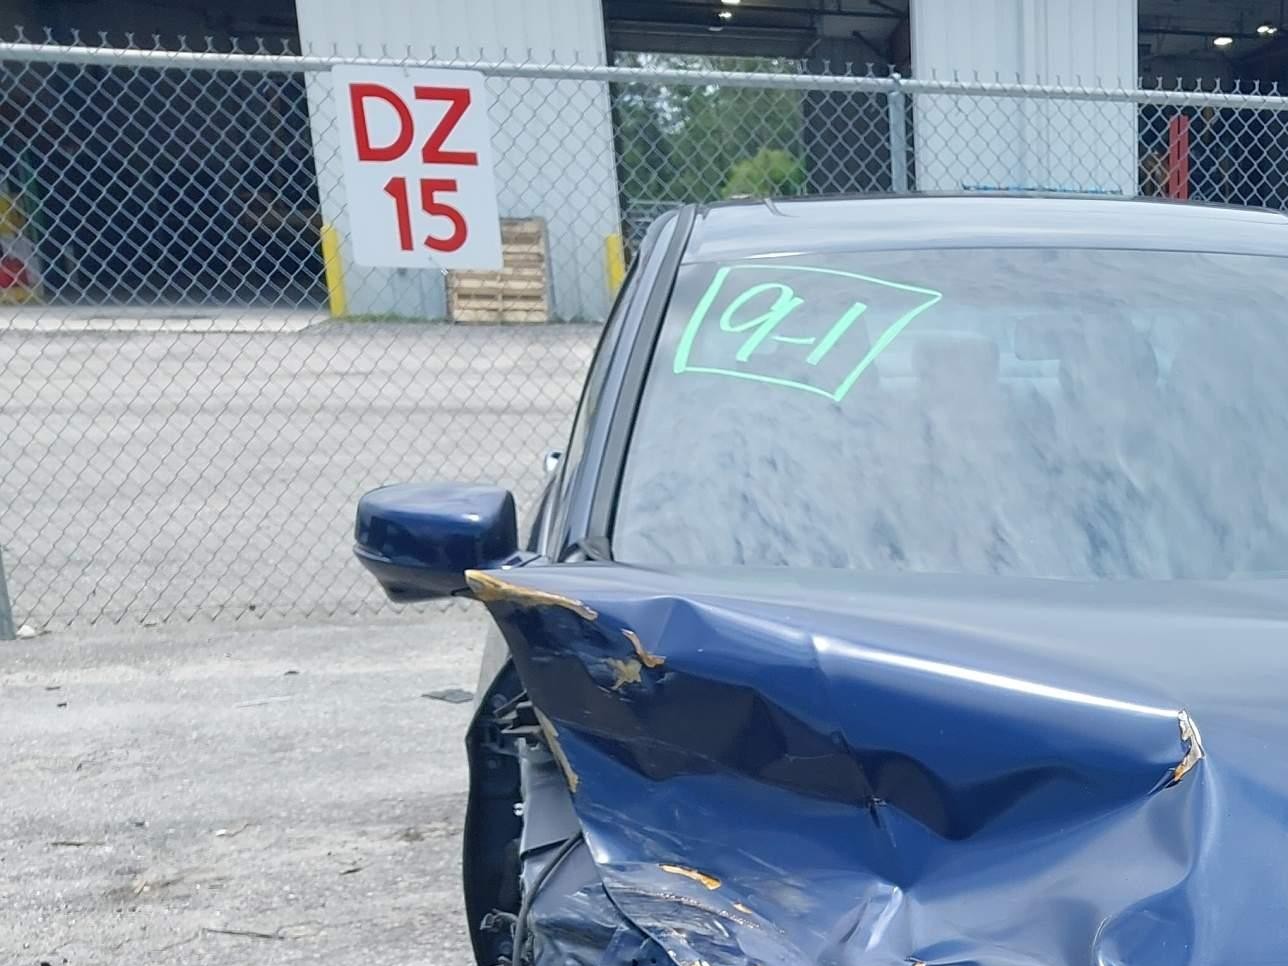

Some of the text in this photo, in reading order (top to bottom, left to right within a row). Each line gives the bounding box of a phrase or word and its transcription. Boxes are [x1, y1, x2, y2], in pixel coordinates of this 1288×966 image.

[349, 82, 479, 166] DZ
[383, 176, 468, 253] 15
[719, 283, 868, 366] 9-1
